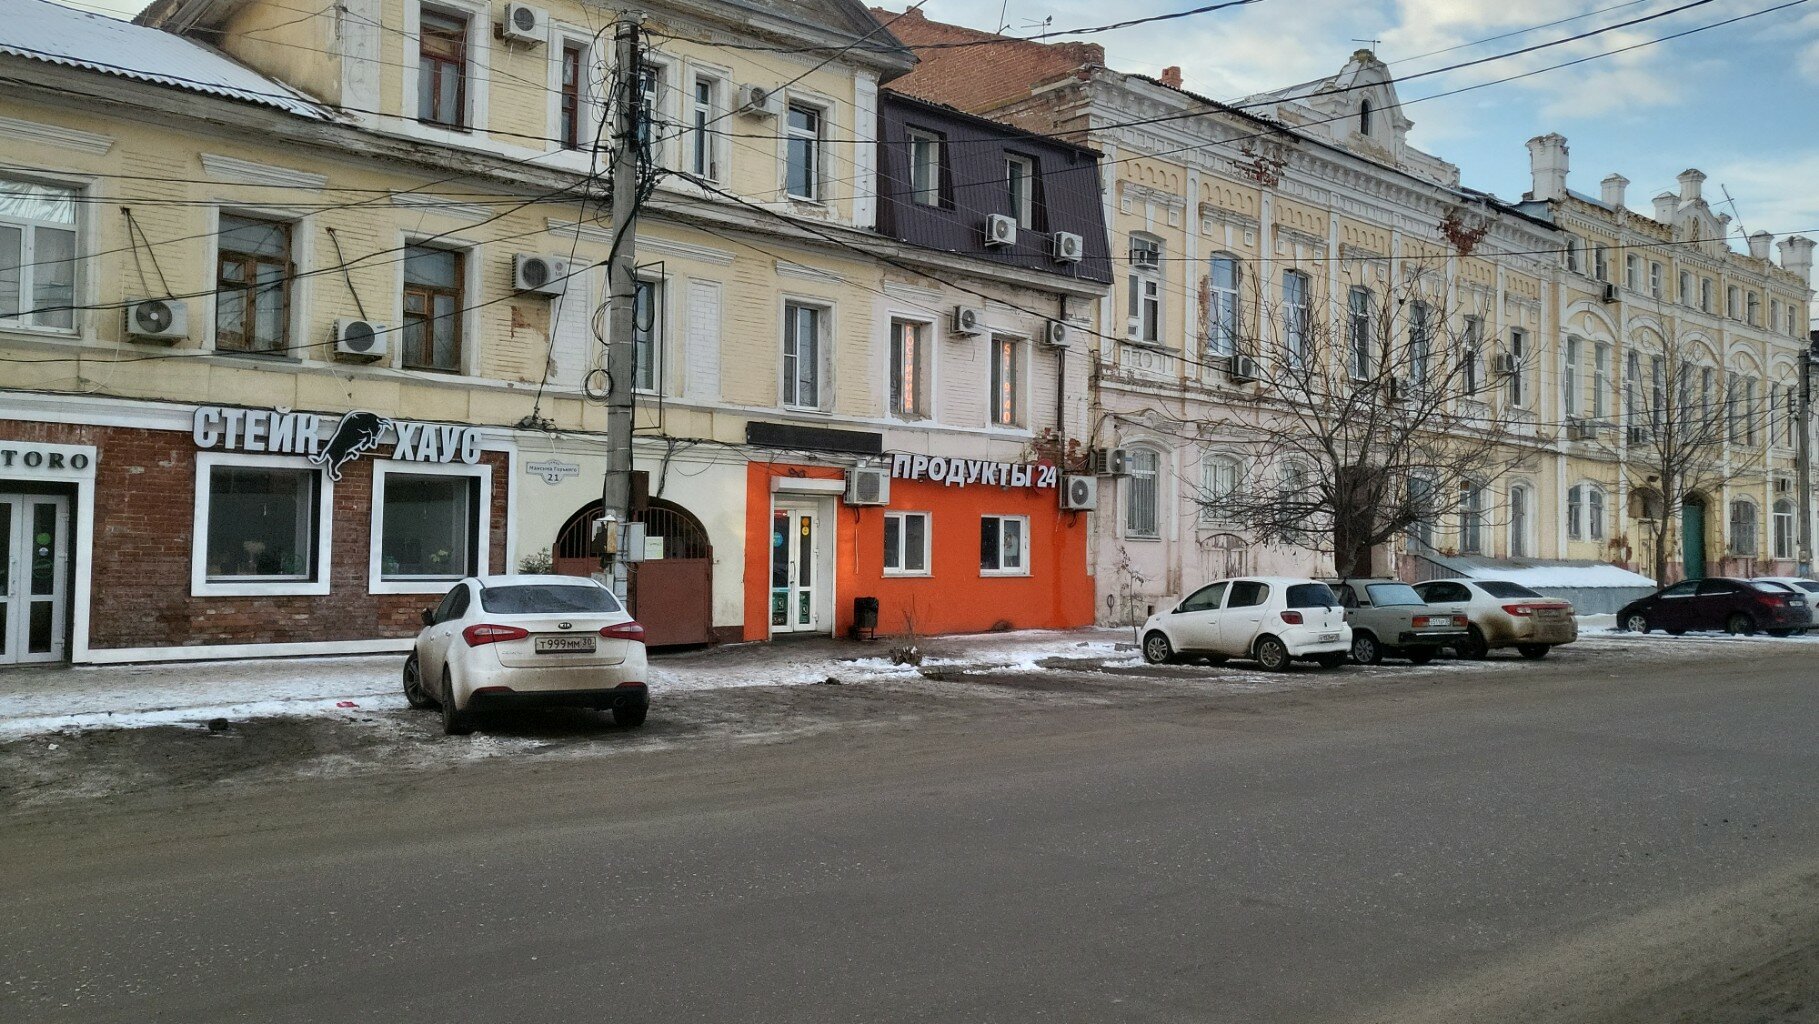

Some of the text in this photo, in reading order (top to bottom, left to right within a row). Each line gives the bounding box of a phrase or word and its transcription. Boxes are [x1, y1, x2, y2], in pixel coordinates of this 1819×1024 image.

[193, 405, 319, 454] СТЕЙК
[392, 421, 483, 465] ХАУС
[1, 450, 89, 469] TORO
[547, 473, 559, 481] 21
[892, 454, 1057, 489] ПРОДУКТЫ 24
